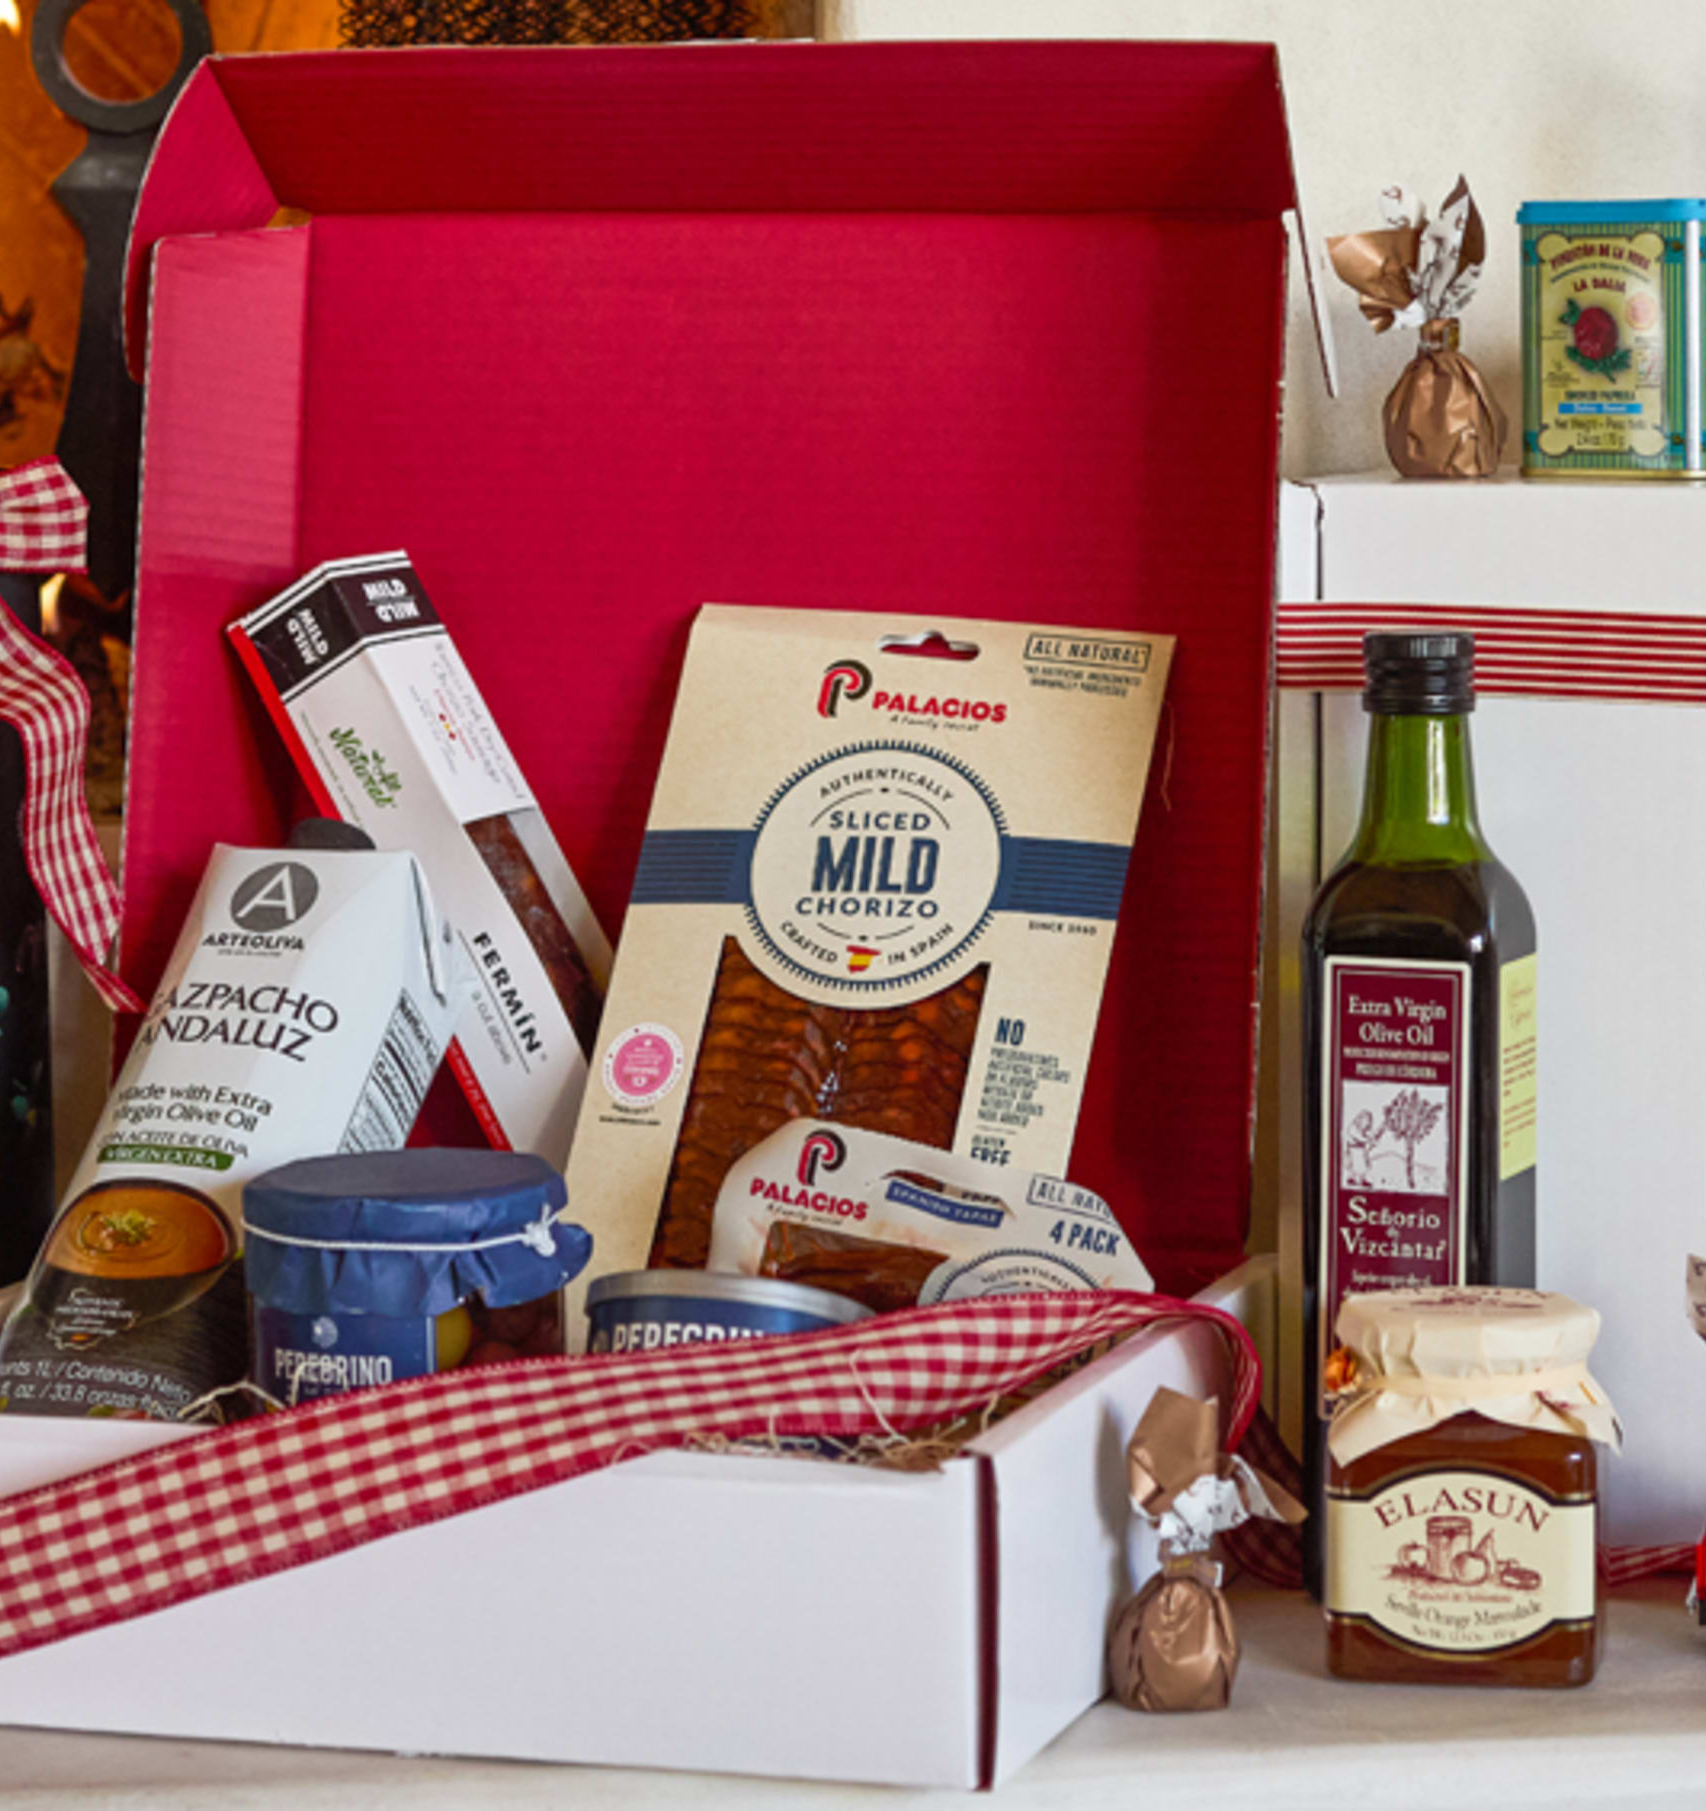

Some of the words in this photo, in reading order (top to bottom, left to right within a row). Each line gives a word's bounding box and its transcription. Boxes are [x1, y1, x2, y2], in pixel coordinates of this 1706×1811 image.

[872, 690, 1007, 724] PALACIOS
[819, 768, 954, 802] AUTHENTICALLY
[829, 810, 931, 832] SLICED
[810, 835, 941, 895] MILD
[795, 896, 940, 919] CHORIZO
[202, 932, 306, 951] ARTEOLIVA
[779, 921, 838, 966] CRAFTED
[888, 949, 906, 967] IN
[909, 922, 954, 958] SPAIN
[473, 931, 543, 1054] FERMÍN
[995, 1016, 1026, 1047] NO
[215, 1086, 273, 1117] Extra
[749, 1177, 870, 1222] PALACIOS
[1049, 1220, 1065, 1244] 4
[1067, 1223, 1121, 1257] PACK
[1375, 1487, 1550, 1533] ELASUN
